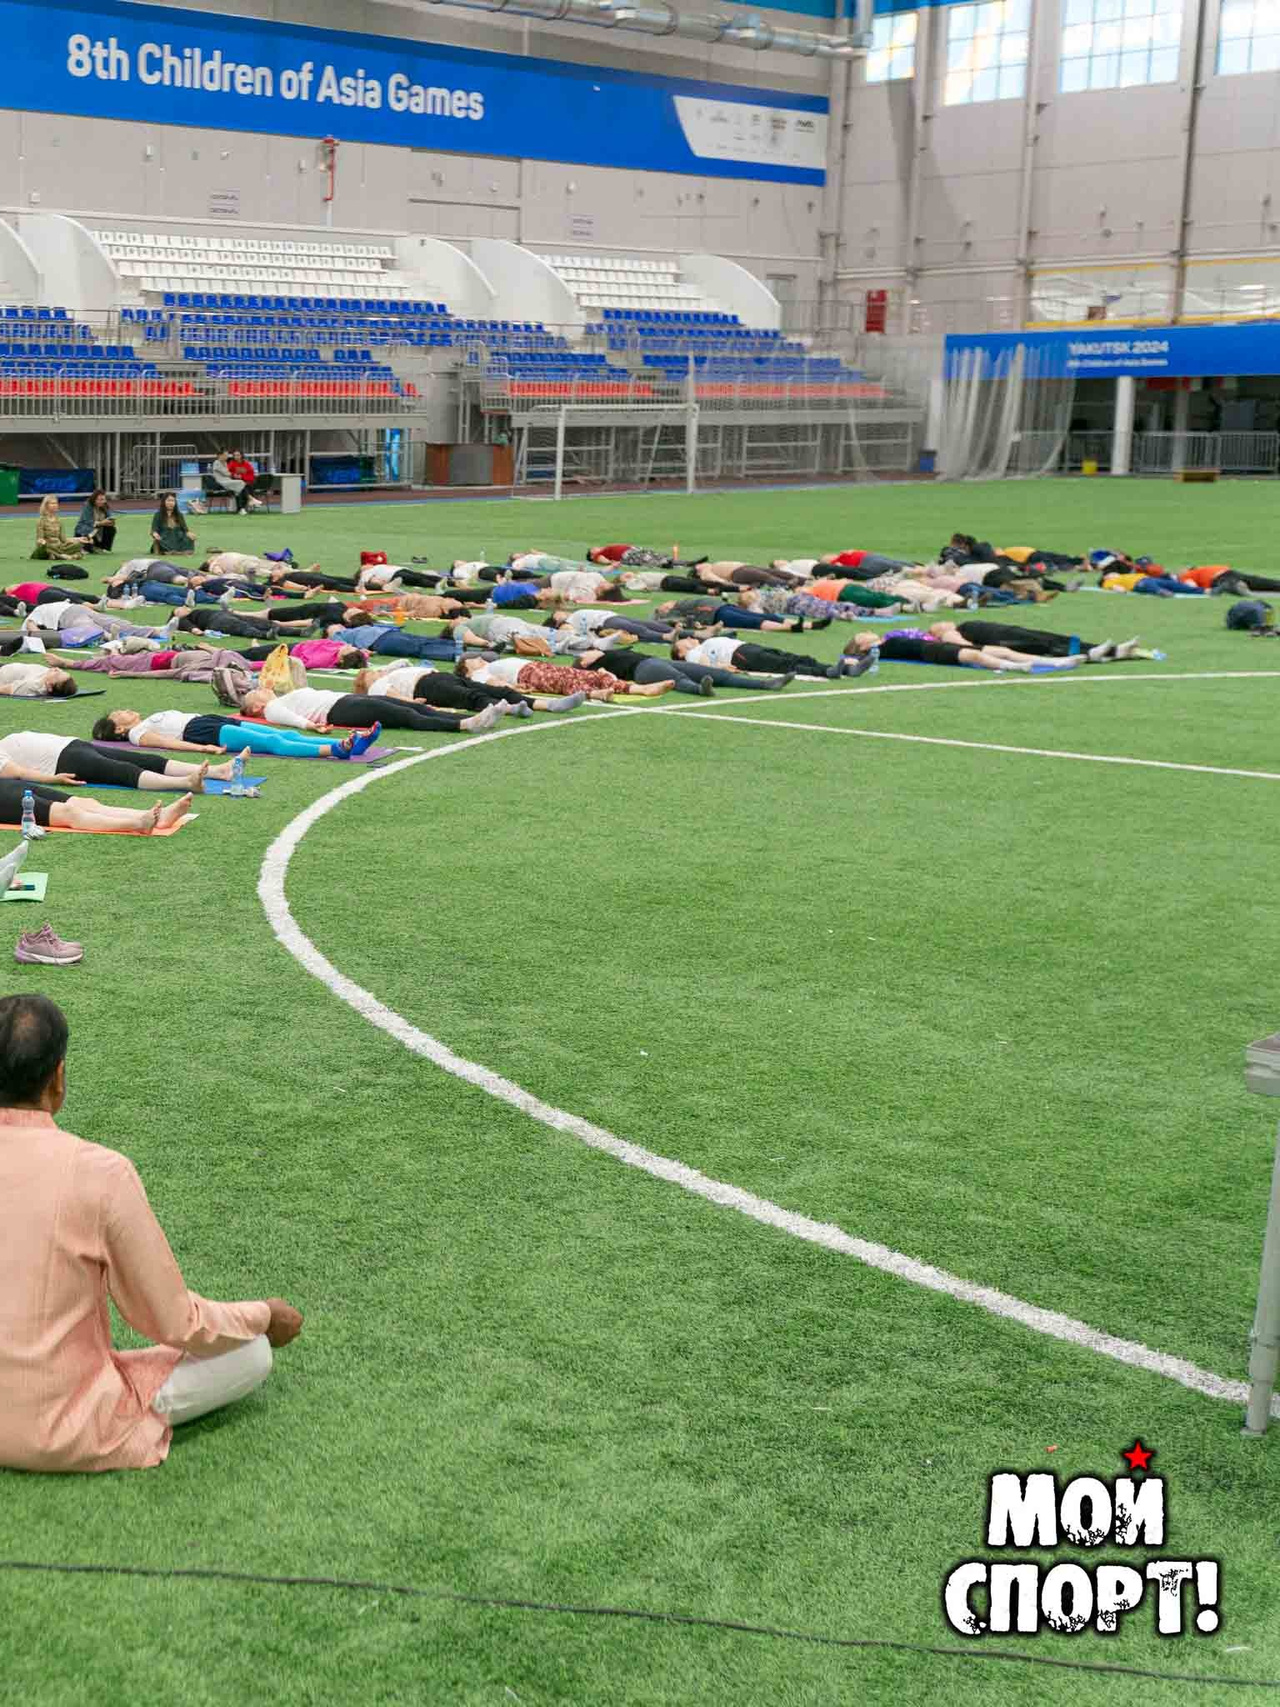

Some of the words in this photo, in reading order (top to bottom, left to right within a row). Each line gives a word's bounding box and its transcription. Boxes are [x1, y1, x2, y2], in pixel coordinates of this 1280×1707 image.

[67, 34, 130, 81] 8th
[138, 43, 274, 97] Children
[280, 61, 314, 100] of
[317, 65, 382, 109] Asia
[388, 73, 484, 121] Games
